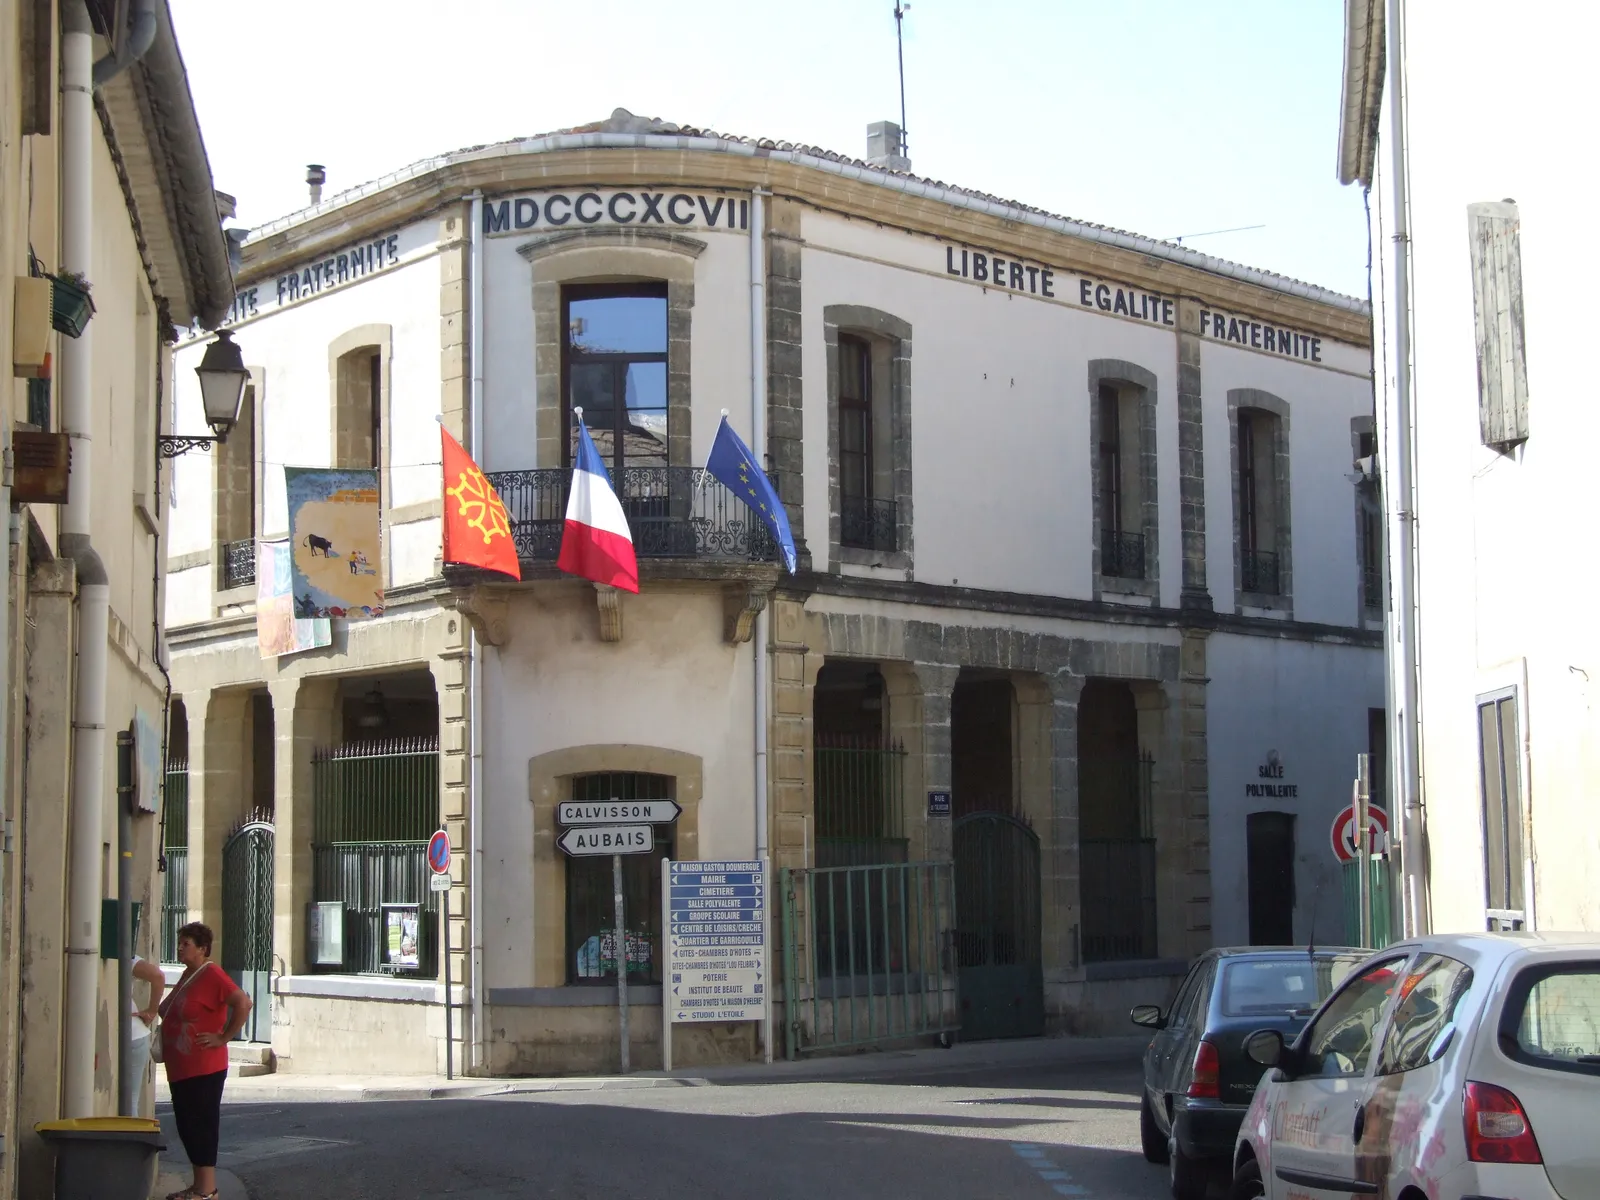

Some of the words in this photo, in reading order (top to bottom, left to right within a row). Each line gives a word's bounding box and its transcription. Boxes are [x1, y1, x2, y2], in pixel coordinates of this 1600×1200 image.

[483, 192, 748, 233] MDCCCXCVII
[276, 234, 399, 305] FRATERNITE
[946, 246, 1055, 298] LIBERTE
[1080, 279, 1174, 326] EGALITE
[1199, 309, 1322, 362] FRATERNITE
[1258, 764, 1284, 779] SALLE
[1245, 783, 1298, 798] POLYVALENTE
[565, 806, 652, 819] CALVISSON
[576, 832, 645, 848] AUBAIS
[680, 863, 702, 872] MAISON
[703, 862, 725, 872] GASTON
[726, 862, 760, 871] DOUMERGUE
[701, 875, 726, 884] MAIRIE
[699, 887, 734, 896] CIMETIERE
[688, 899, 704, 908] SALLE
[705, 899, 741, 908] POLYVALENTE
[689, 912, 712, 920] GROUPE
[713, 911, 740, 920] SCOLAIRE
[680, 924, 703, 933] CENTRE
[704, 924, 713, 933] DE
[680, 937, 710, 946] QUARTIER
[710, 937, 719, 945] DE
[679, 949, 695, 958] GITES
[698, 949, 728, 957] CHAMBRES
[729, 948, 752, 957] D'HOTES
[702, 973, 728, 982] POTERIE
[688, 986, 713, 995] INSTITUT
[713, 985, 721, 994] DE
[722, 985, 743, 994] BEAUTE
[680, 998, 702, 1008] CHAMBRES
[691, 1011, 715, 1019] STUDIO
[717, 1010, 745, 1018] L'ETOILE
